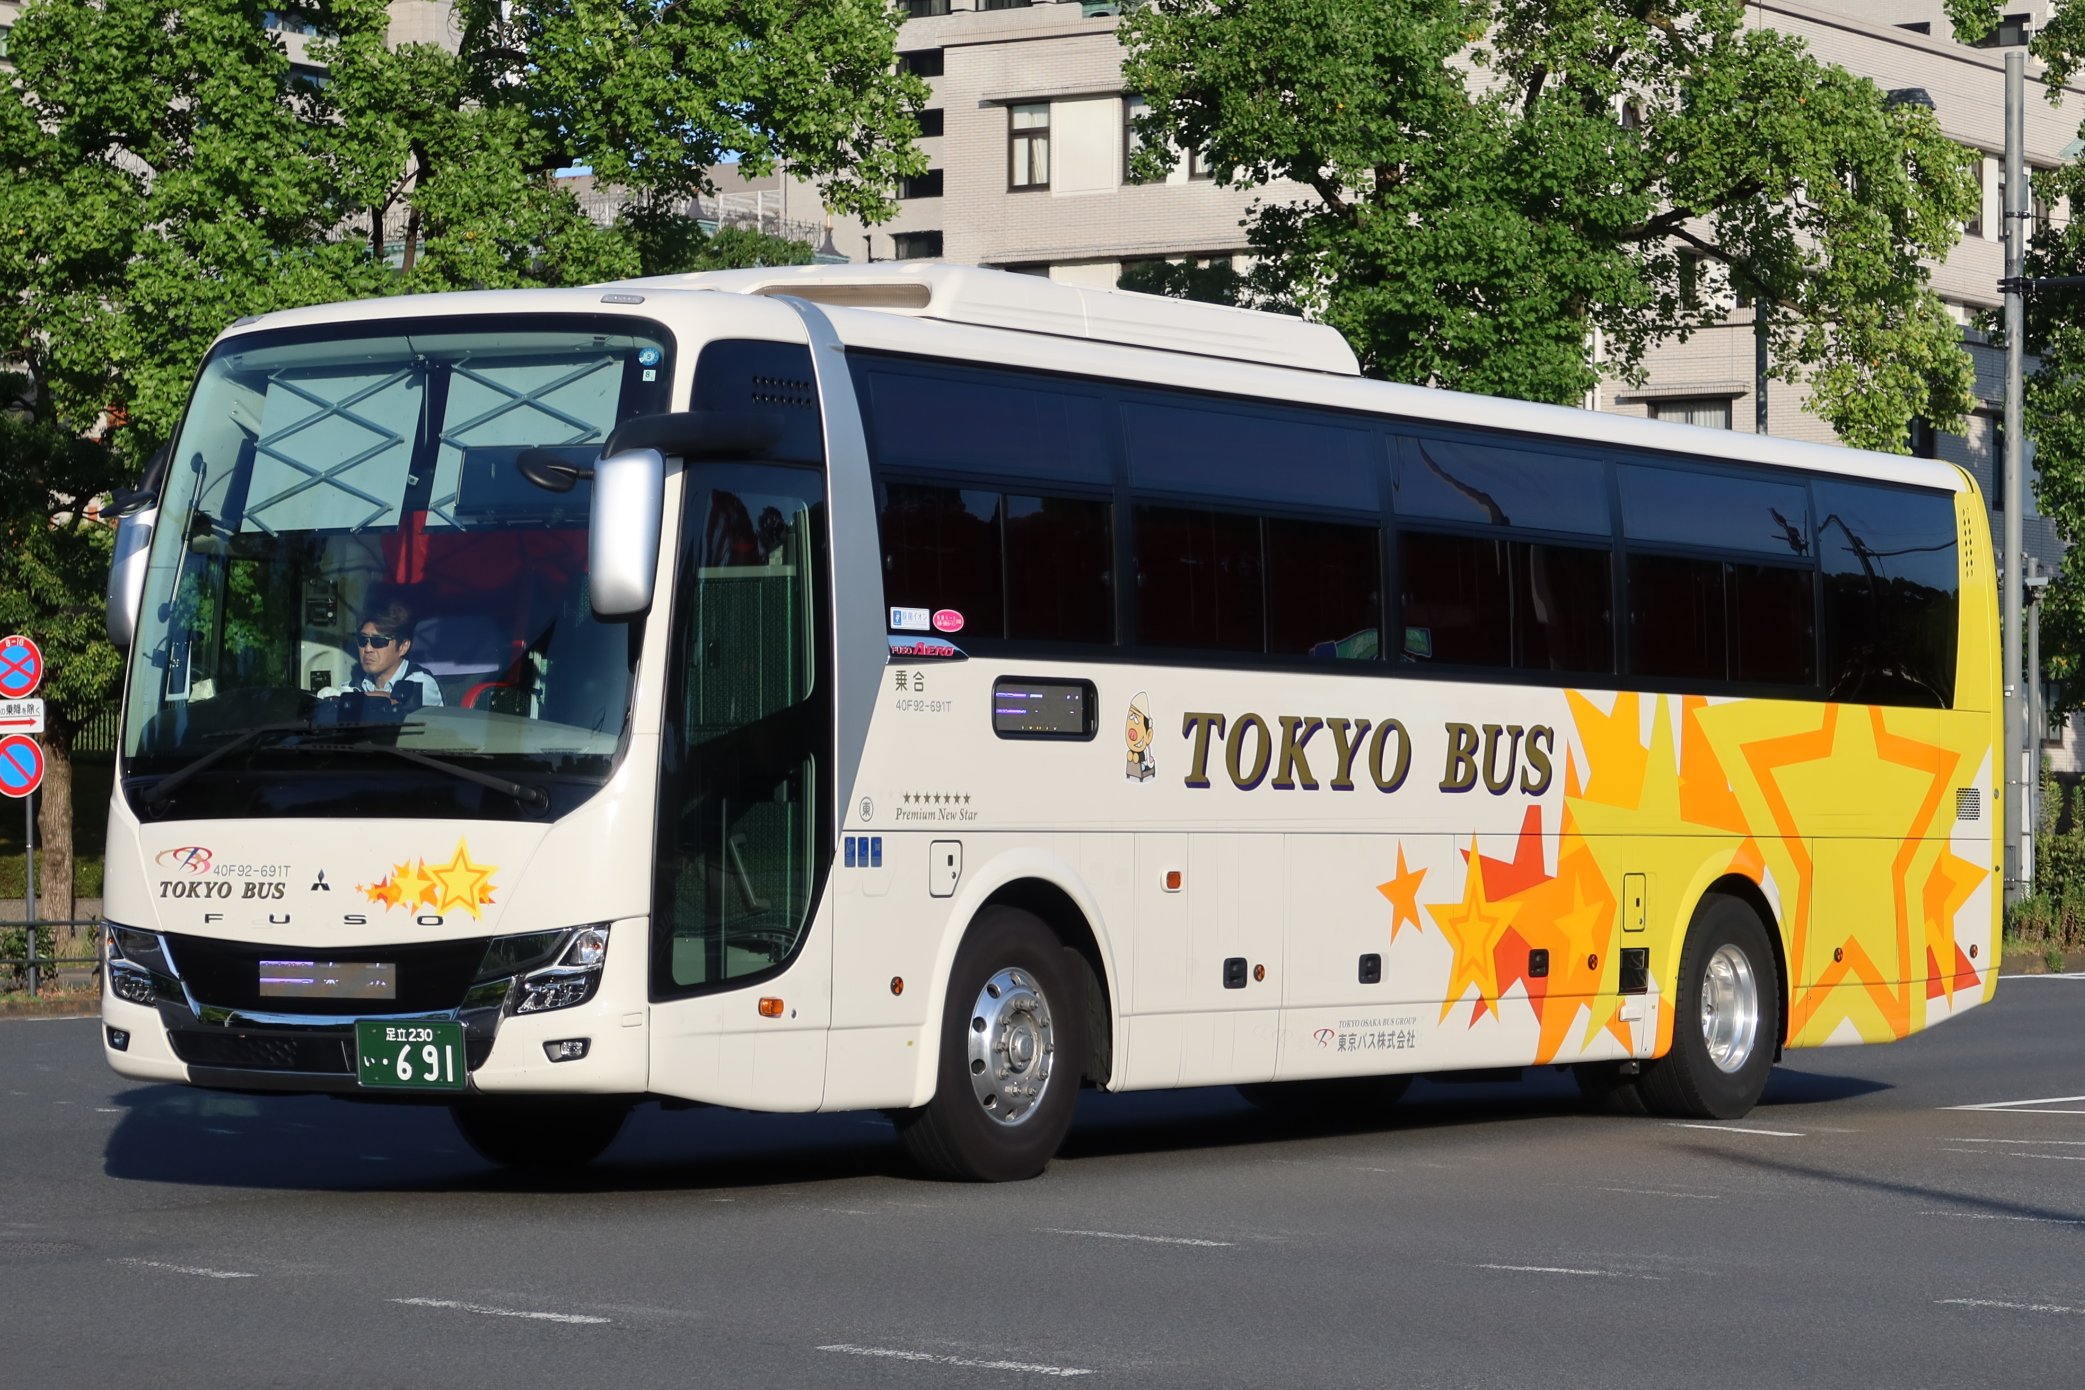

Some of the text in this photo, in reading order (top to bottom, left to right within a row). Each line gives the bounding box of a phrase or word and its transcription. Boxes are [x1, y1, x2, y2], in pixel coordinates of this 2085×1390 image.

[895, 670, 925, 692] 乗合
[895, 699, 952, 713] 40F92-691T
[1182, 711, 1555, 797] TOKYO BUS
[895, 807, 978, 821] Premium New Star
[213, 864, 292, 878] 40F92-691T
[160, 880, 286, 900] TOKYO BUS
[1339, 1020, 1360, 1028] TOKYO
[1360, 1019, 1381, 1027] OSAKA
[1395, 1016, 1416, 1025] GROUP
[385, 1027, 433, 1042] 足立230
[1337, 1029, 1415, 1052] 東京バス株式会社
